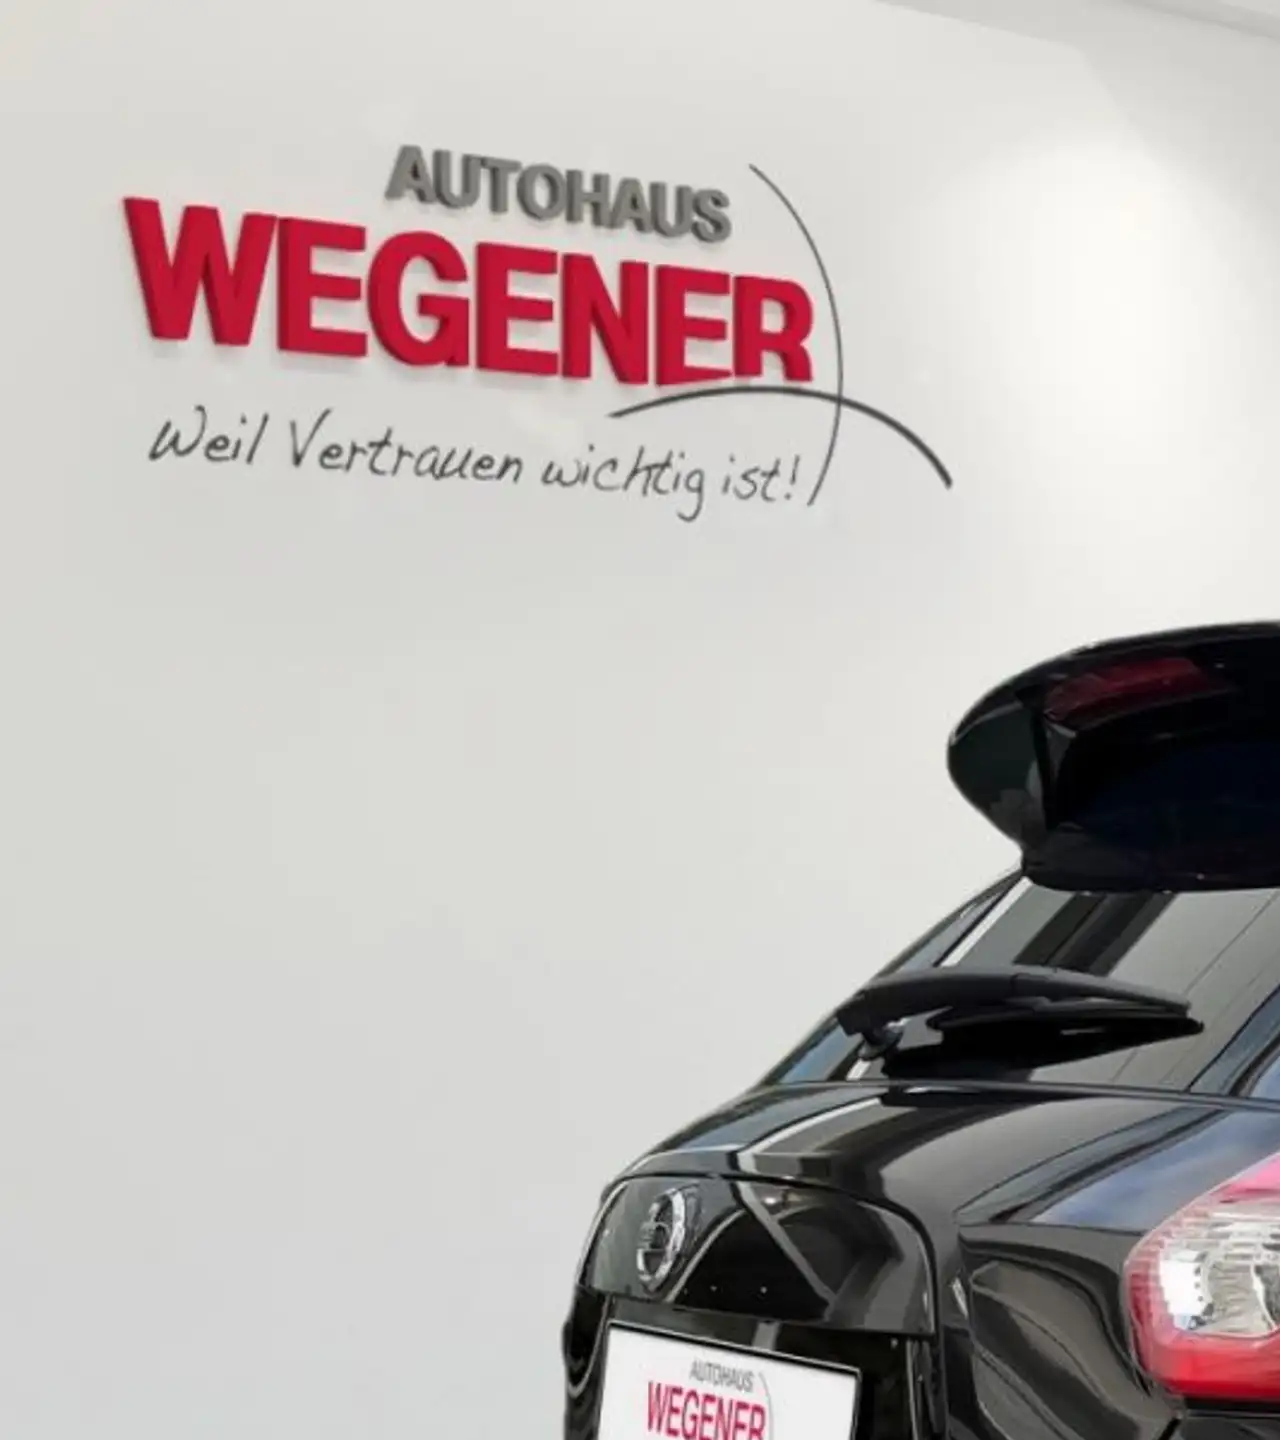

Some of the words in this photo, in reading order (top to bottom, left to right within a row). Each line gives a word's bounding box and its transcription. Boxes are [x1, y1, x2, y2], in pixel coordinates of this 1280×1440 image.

[385, 145, 732, 244] AUTOHAUS
[123, 197, 815, 386] WEGENER
[149, 403, 270, 463] Weil
[288, 407, 524, 482] Vertrauen
[541, 443, 706, 522] wichtig
[720, 454, 800, 502] ist!
[689, 1359, 755, 1393] AUTOHAUS
